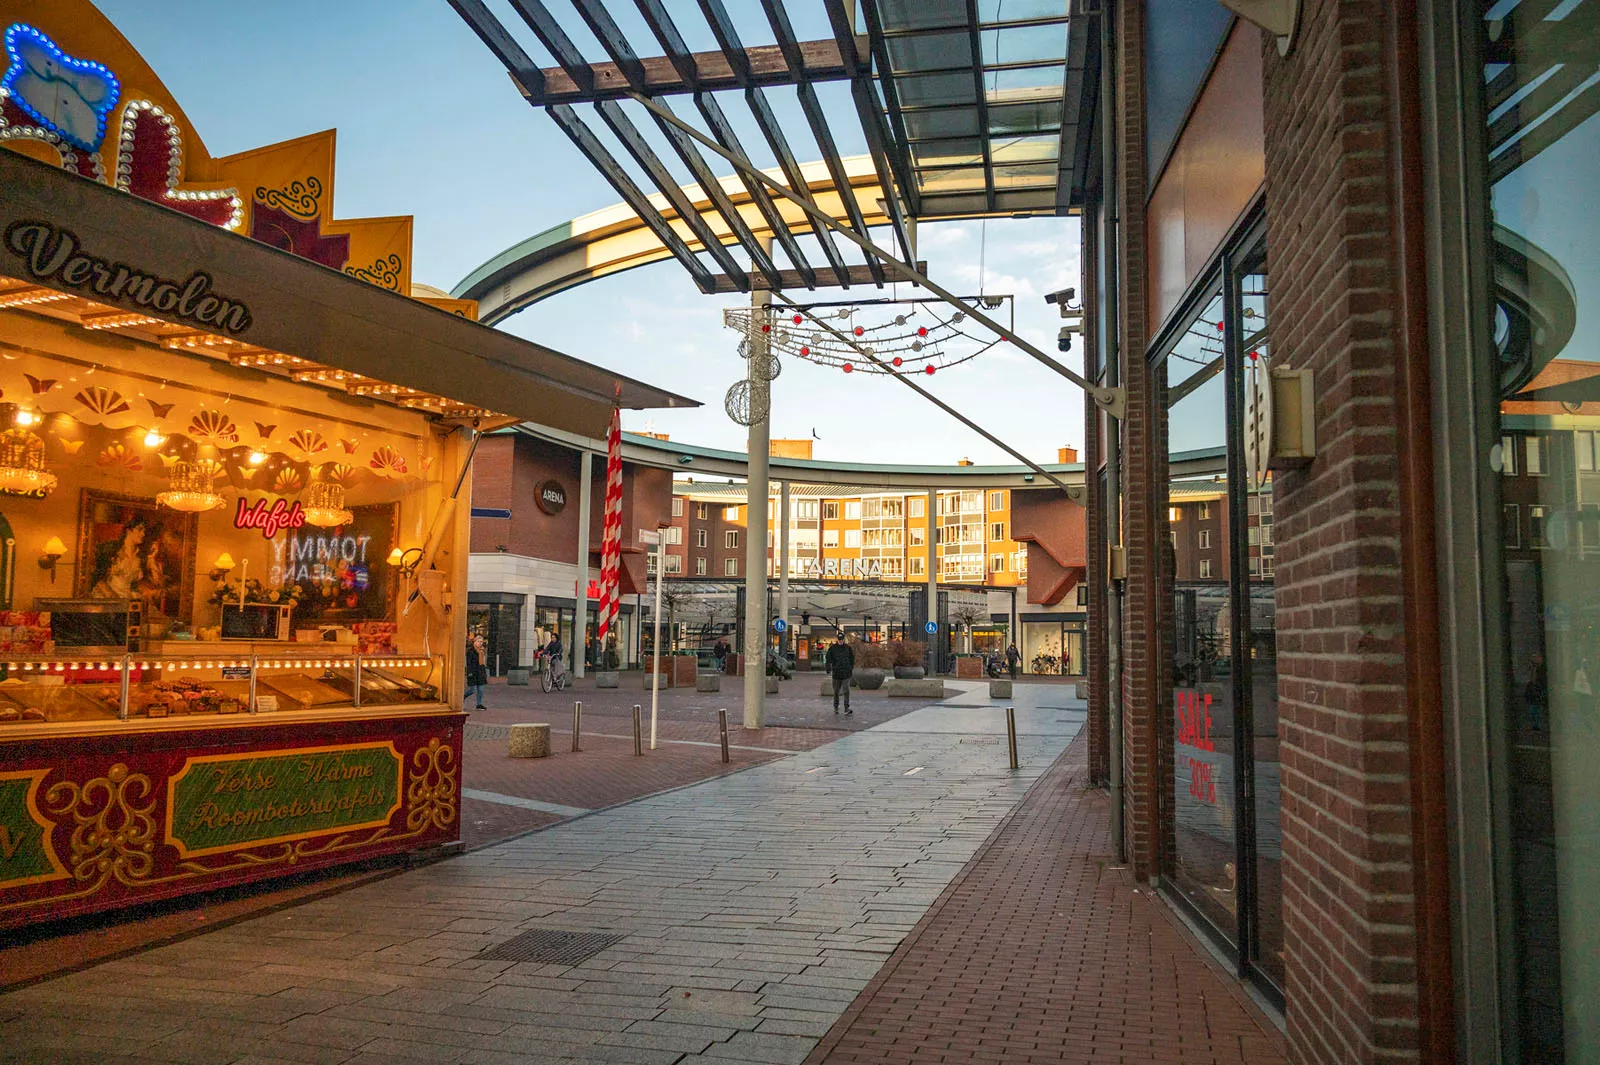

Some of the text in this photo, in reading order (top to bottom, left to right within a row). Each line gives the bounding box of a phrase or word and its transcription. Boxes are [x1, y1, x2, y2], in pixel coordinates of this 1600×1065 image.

[5, 220, 250, 332] Vermolen
[235, 497, 307, 539] Wafels
[542, 489, 565, 505] ARENA
[807, 557, 883, 577] ARENA
[1178, 692, 1214, 753] SALE
[212, 759, 374, 794] Verse Warme
[1188, 757, 1216, 804] 30%
[189, 786, 384, 829] Roomboterwafels
